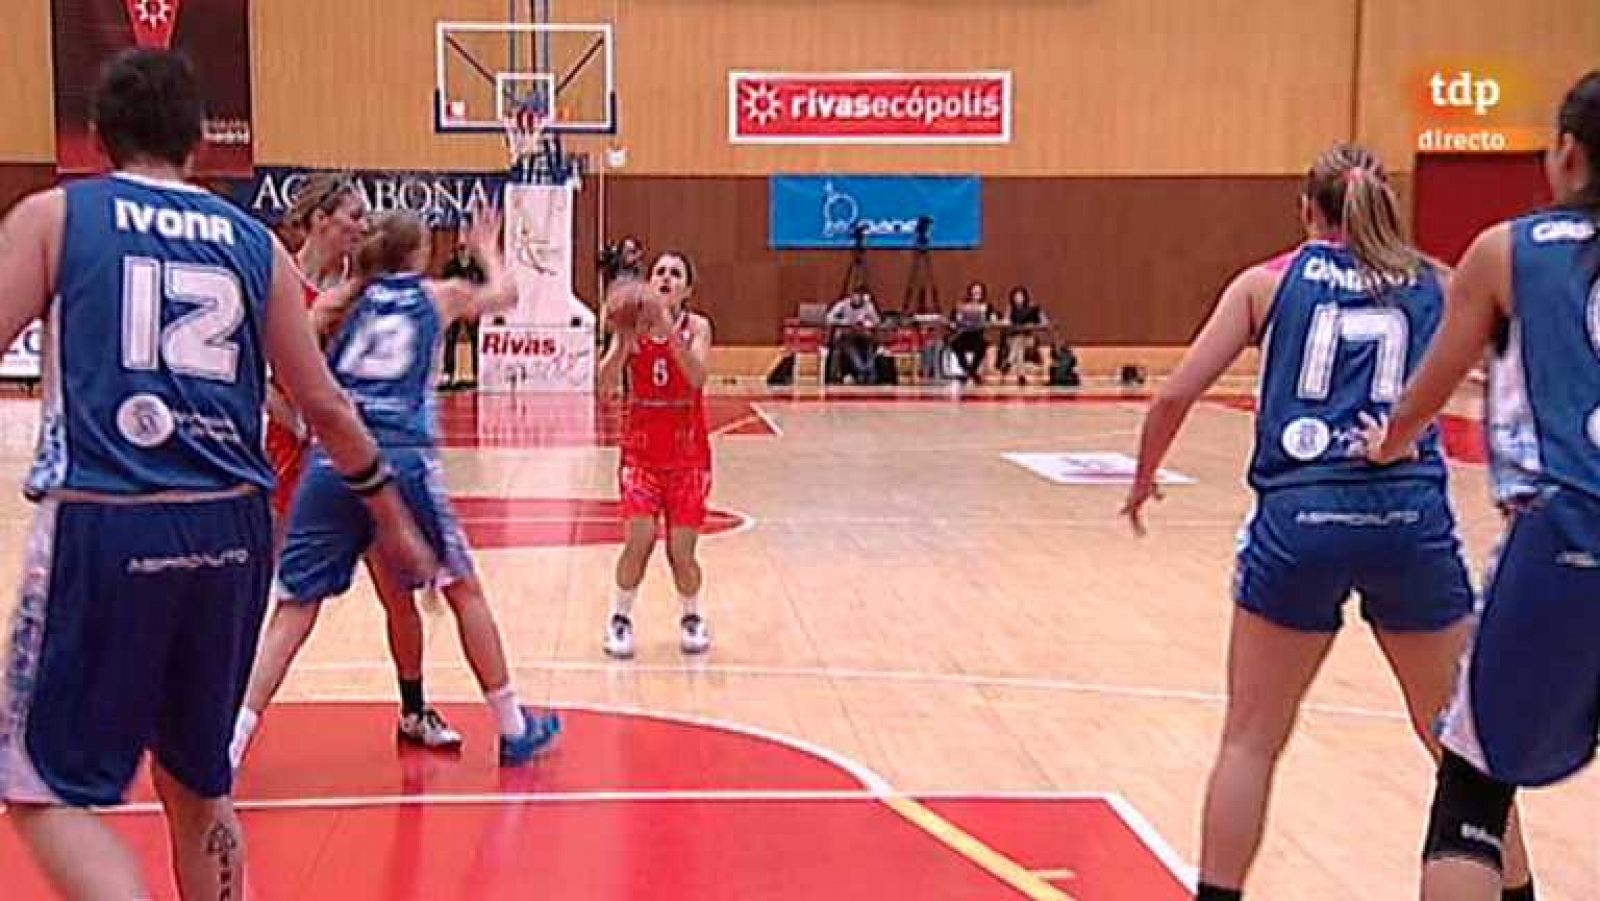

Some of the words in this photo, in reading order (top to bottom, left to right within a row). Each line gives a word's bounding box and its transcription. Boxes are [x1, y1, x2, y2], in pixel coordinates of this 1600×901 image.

[791, 86, 1000, 126] rivasecópolis
[252, 173, 490, 215] AABONA
[122, 255, 245, 384] 12
[482, 332, 557, 355] Rivas
[1297, 301, 1410, 402] 17
